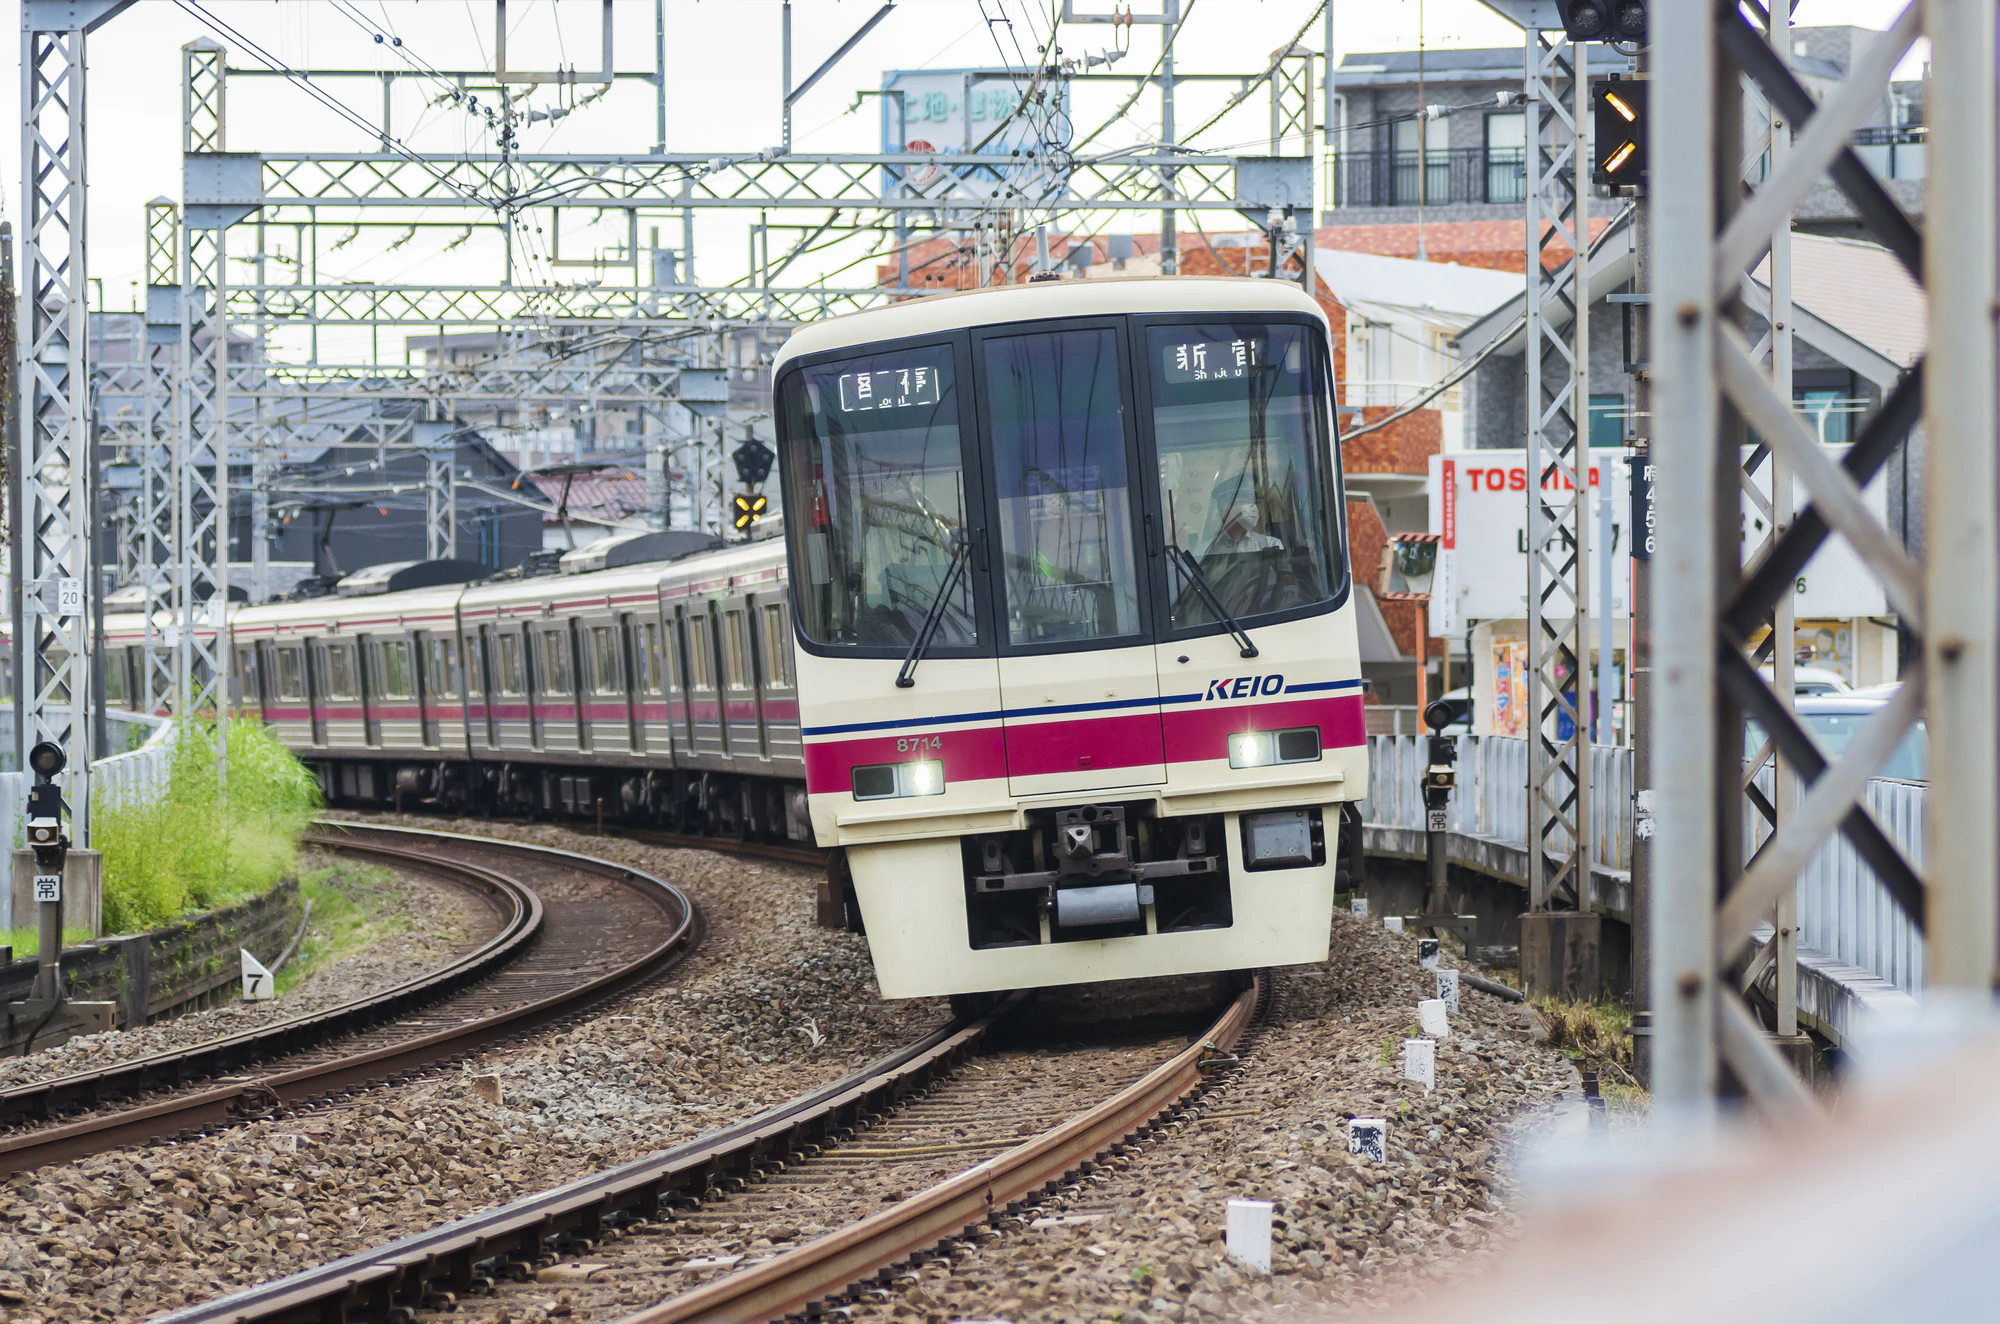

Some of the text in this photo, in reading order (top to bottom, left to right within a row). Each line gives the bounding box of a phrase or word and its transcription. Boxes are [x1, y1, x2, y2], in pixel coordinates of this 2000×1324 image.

[1466, 467, 1600, 492] TOSIA
[62, 591, 78, 605] 20
[1205, 674, 1284, 702] KEIO
[896, 735, 943, 753] 8714
[1430, 812, 1447, 829] 常
[37, 878, 56, 899] 常
[247, 973, 264, 994] 7
